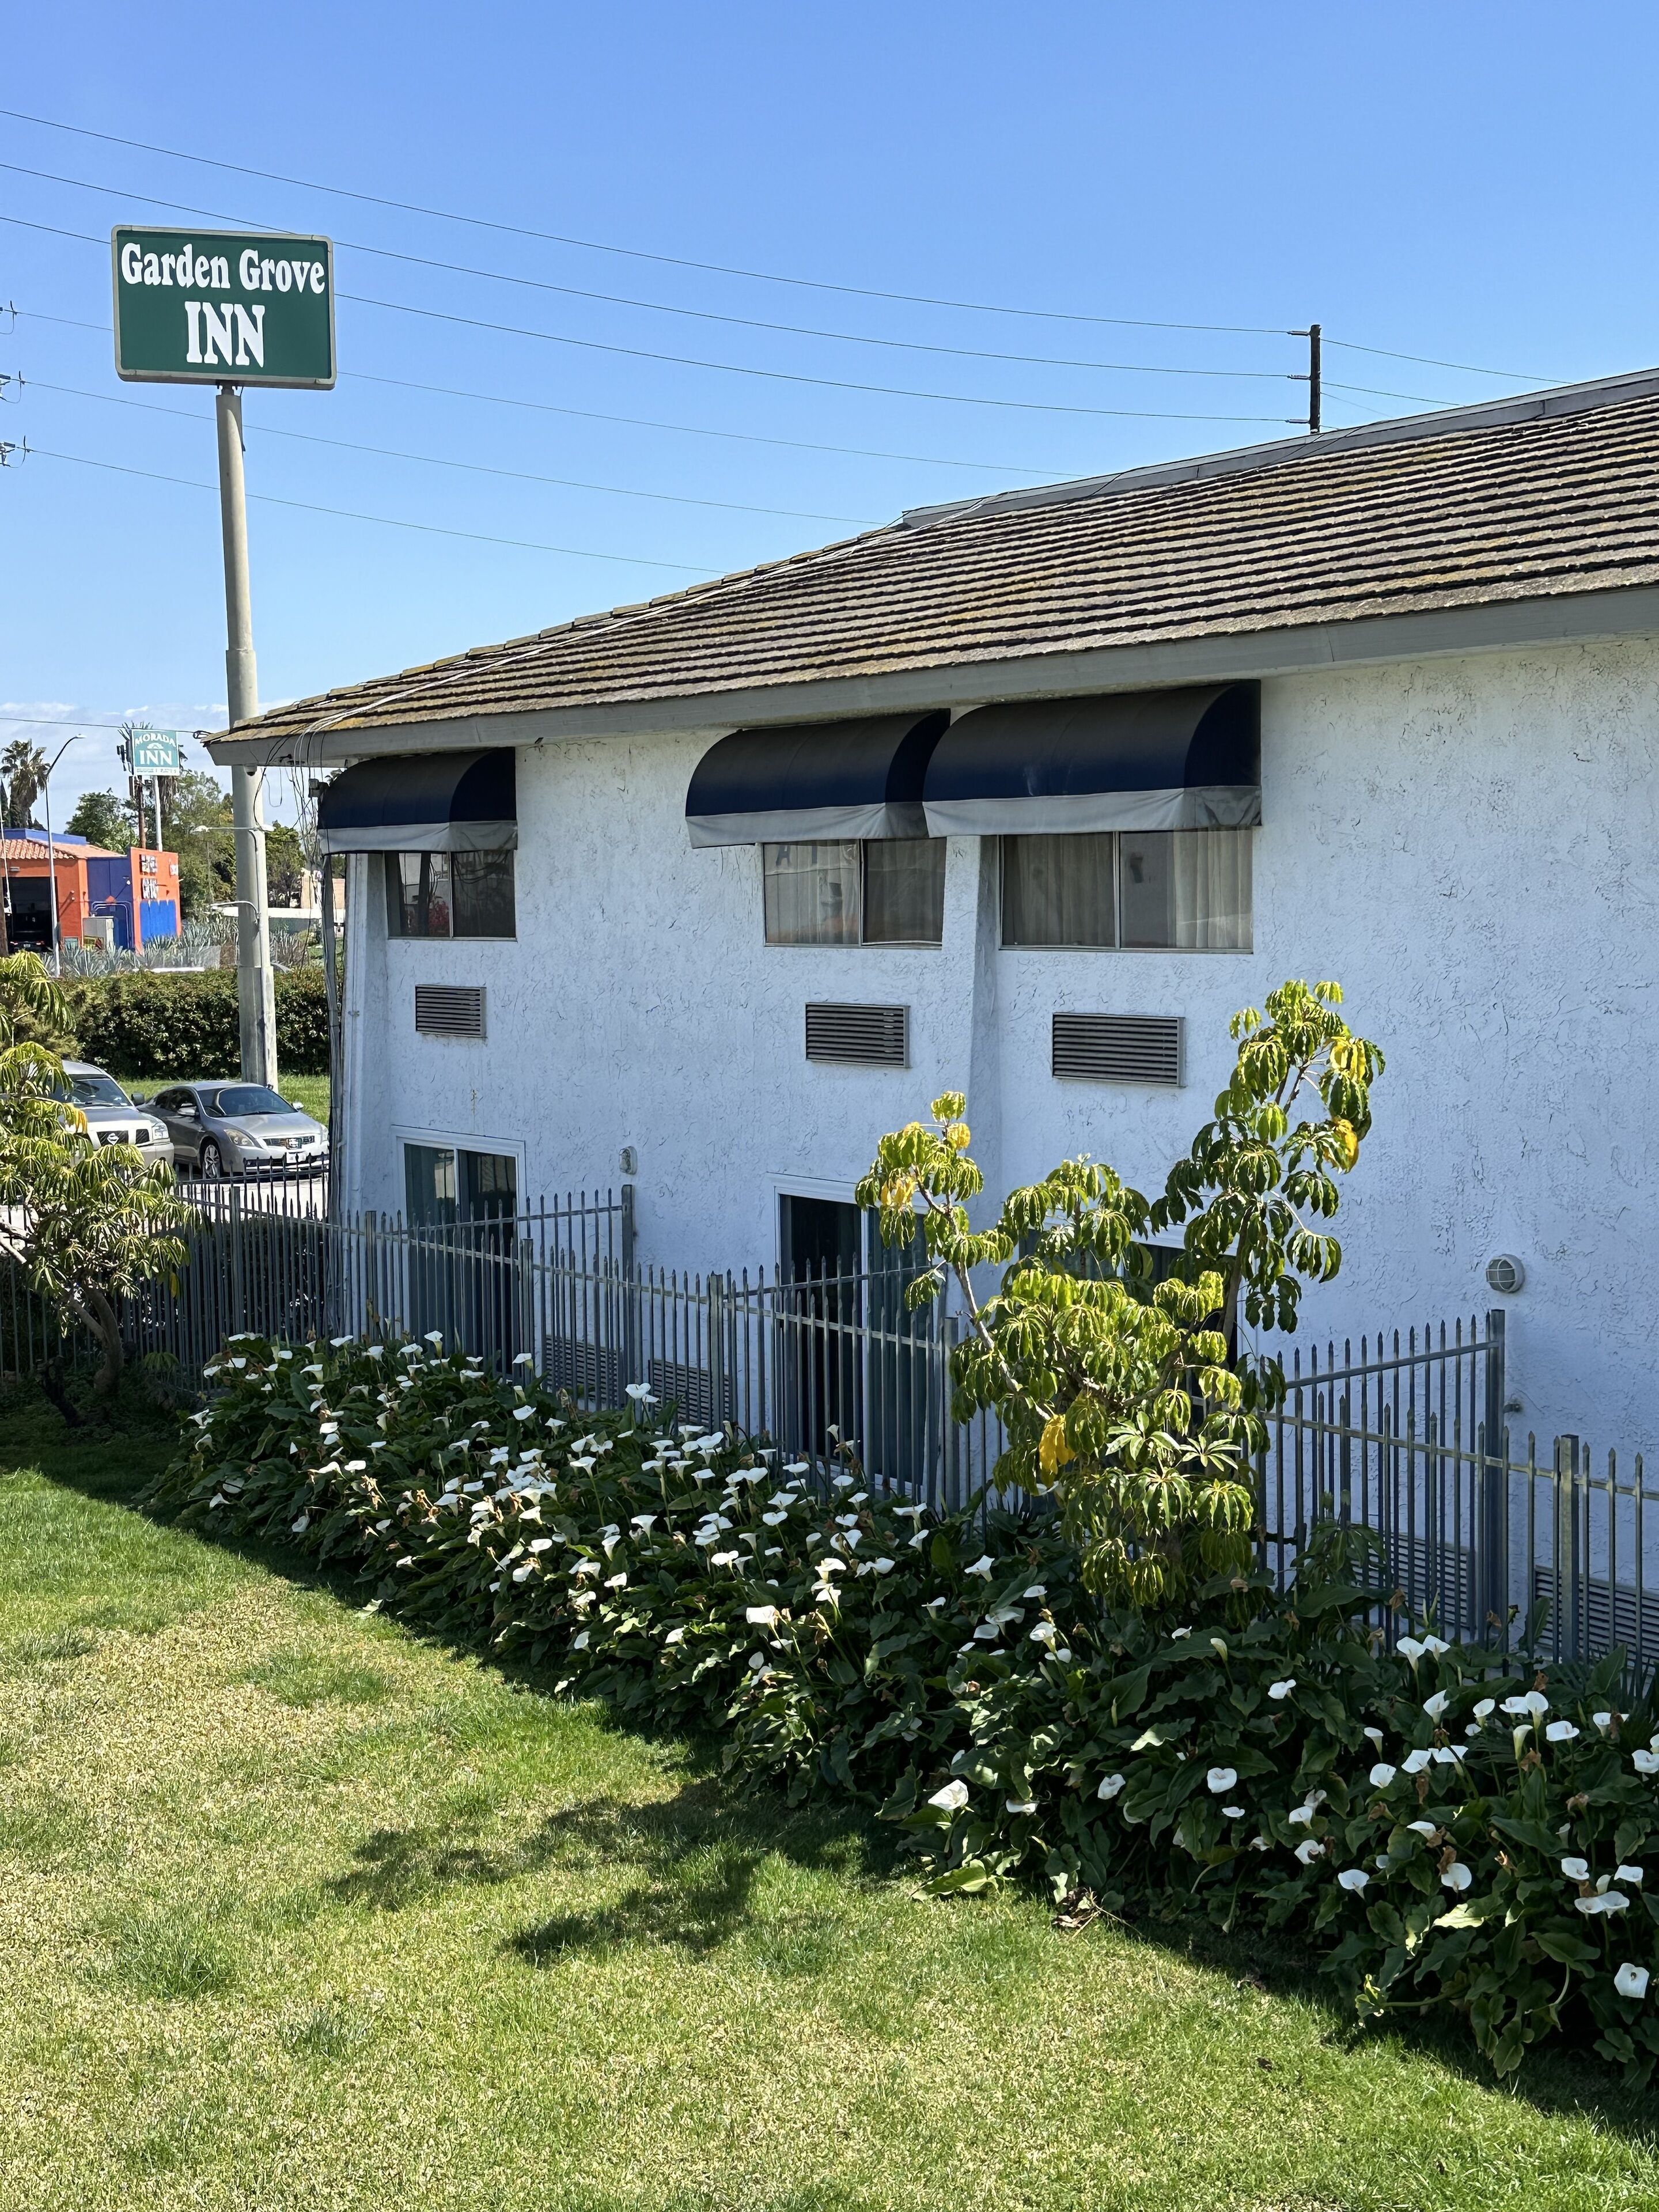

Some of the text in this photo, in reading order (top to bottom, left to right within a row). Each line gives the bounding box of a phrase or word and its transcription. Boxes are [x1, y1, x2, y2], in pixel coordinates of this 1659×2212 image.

[121, 243, 325, 294] Garden Grove
[184, 301, 265, 368] INN
[135, 733, 176, 748] MORADA
[139, 750, 172, 766] INN
